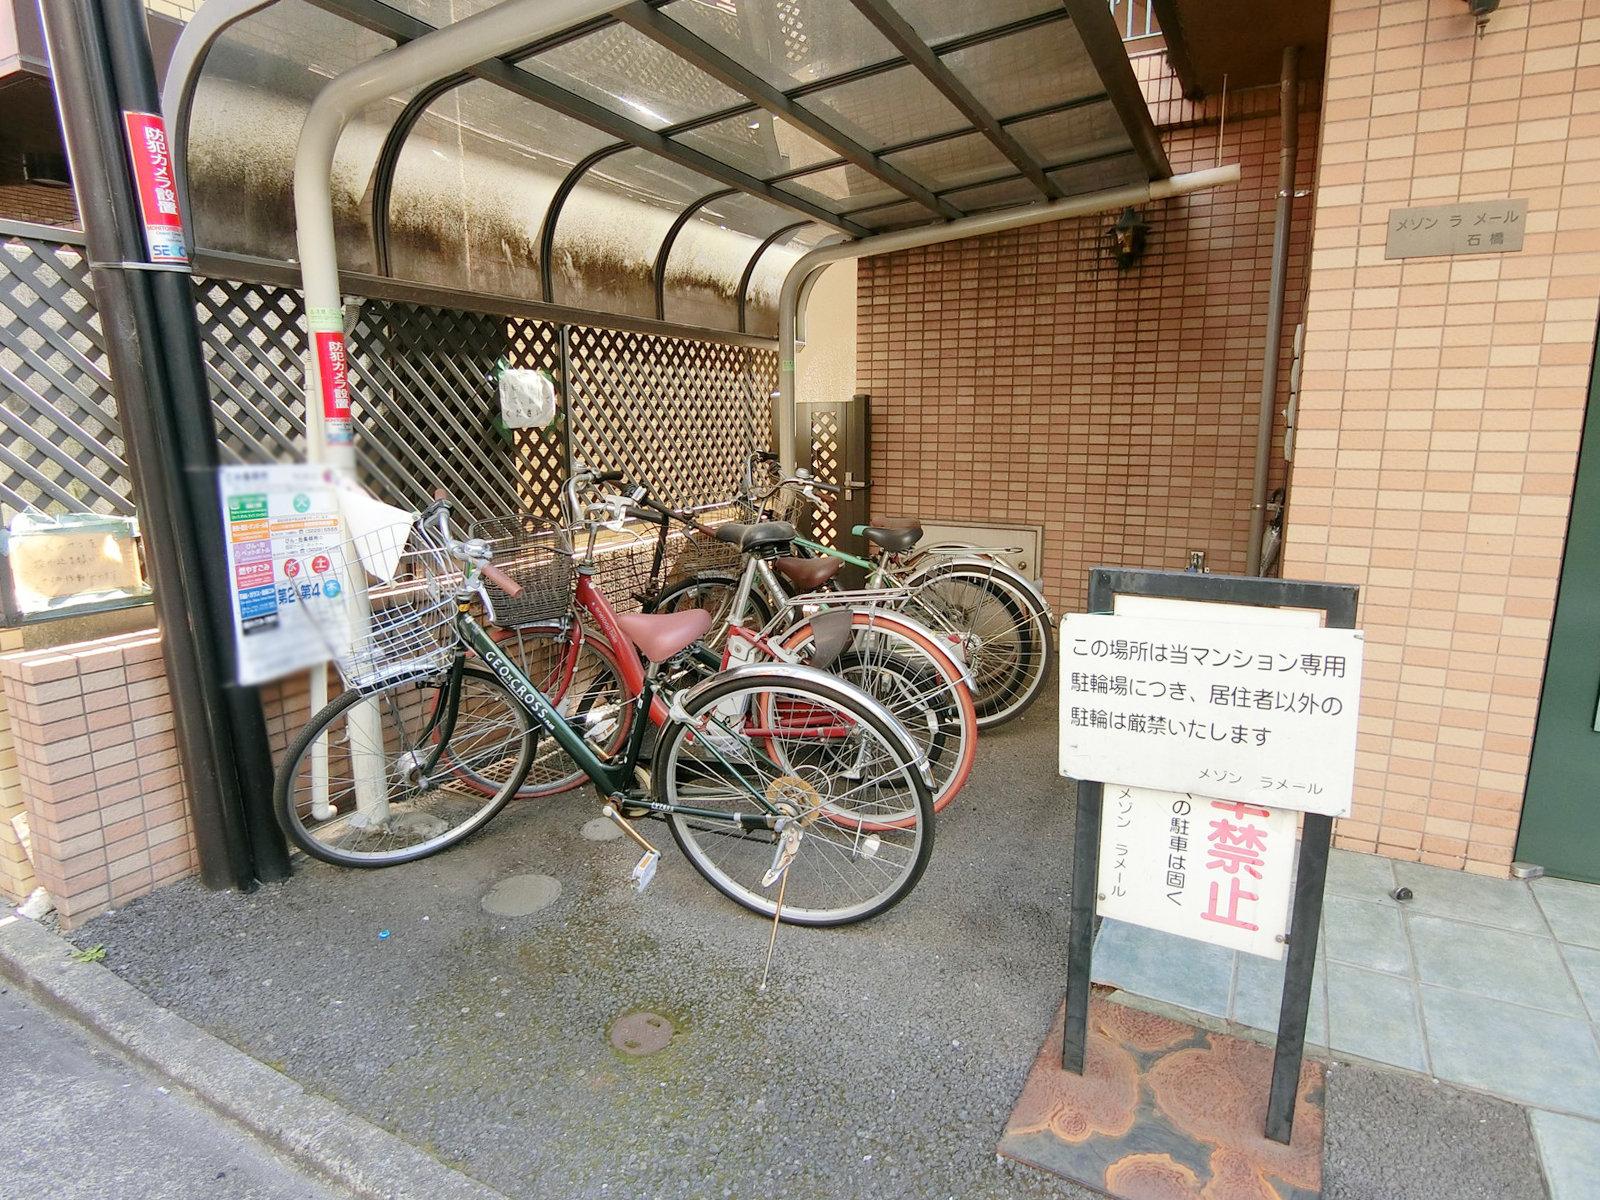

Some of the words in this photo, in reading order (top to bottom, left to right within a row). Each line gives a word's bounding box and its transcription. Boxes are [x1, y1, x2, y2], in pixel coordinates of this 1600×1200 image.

[144, 126, 178, 215] 防犯カメラ設置
[1449, 215, 1463, 227] ラ
[1473, 210, 1519, 226] メール
[328, 341, 350, 410] 防犯カメラ設置
[315, 557, 327, 569] 土
[1072, 636, 1347, 679] この場所は当マンション専用
[1070, 671, 1344, 718] 駐輪場につき、居住者以外の
[1070, 706, 1272, 747] 駐輪は厳禁いたします
[1198, 767, 1243, 785] メゾン
[1260, 775, 1324, 795] ラメール
[1117, 788, 1133, 828] メゾン
[1111, 844, 1128, 897] ラメール
[1166, 792, 1193, 907] の駐車は固く
